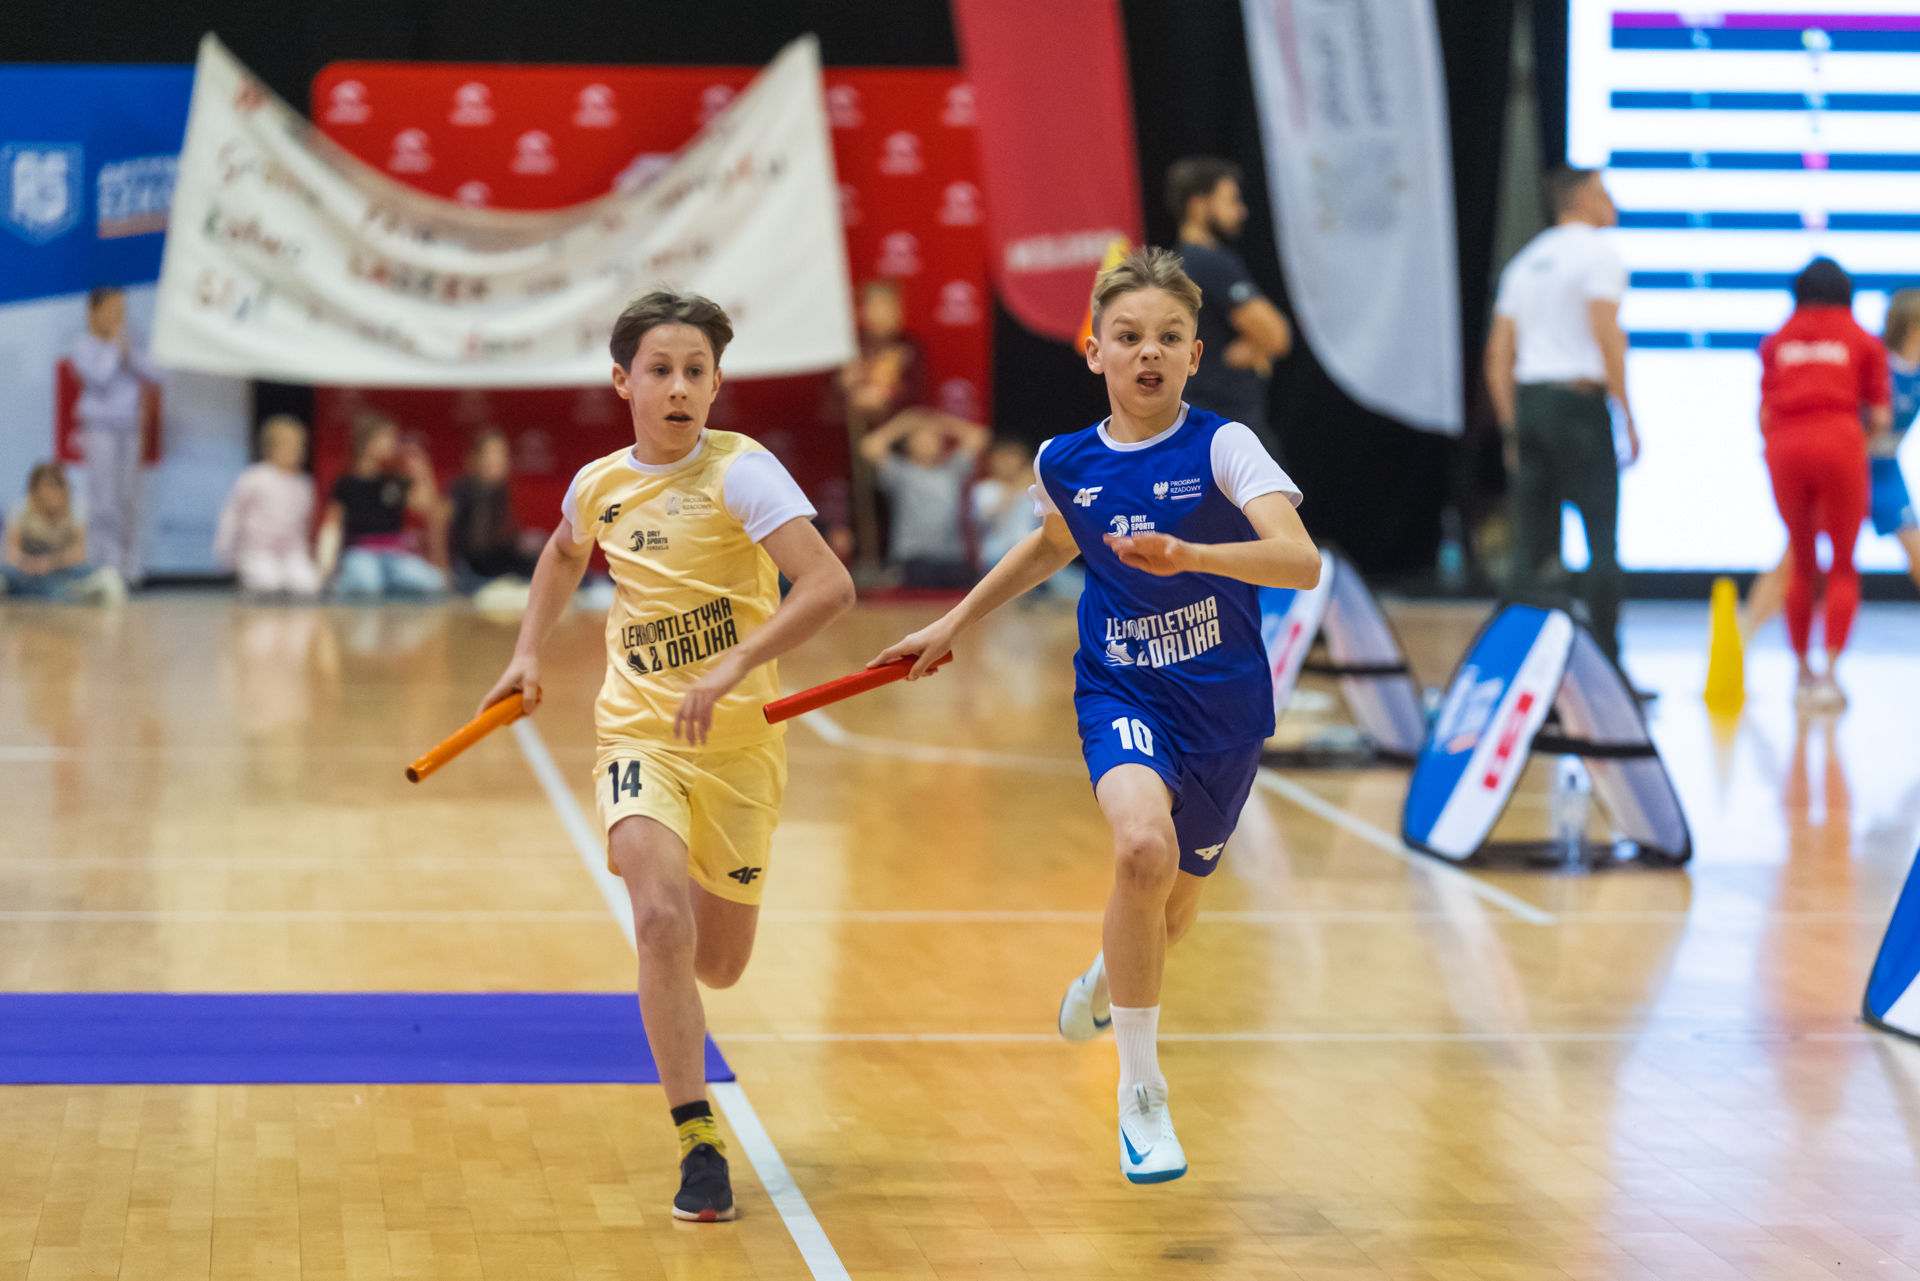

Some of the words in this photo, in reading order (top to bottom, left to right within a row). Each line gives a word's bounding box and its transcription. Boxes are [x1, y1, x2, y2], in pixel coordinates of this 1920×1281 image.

[1170, 477, 1200, 487] PROGRAM
[1170, 484, 1201, 494] RZĄDOWY
[1073, 486, 1103, 507] 4F
[1130, 514, 1147, 523] ORŁY
[1130, 521, 1155, 531] SPORTU
[646, 537, 668, 545] SPORTU
[666, 618, 739, 668] ORLIKA
[1148, 618, 1223, 669] ORLIKA
[1111, 716, 1155, 757] 10
[608, 759, 643, 805] 14
[1194, 842, 1225, 861] 4F
[727, 866, 762, 885] 4F
